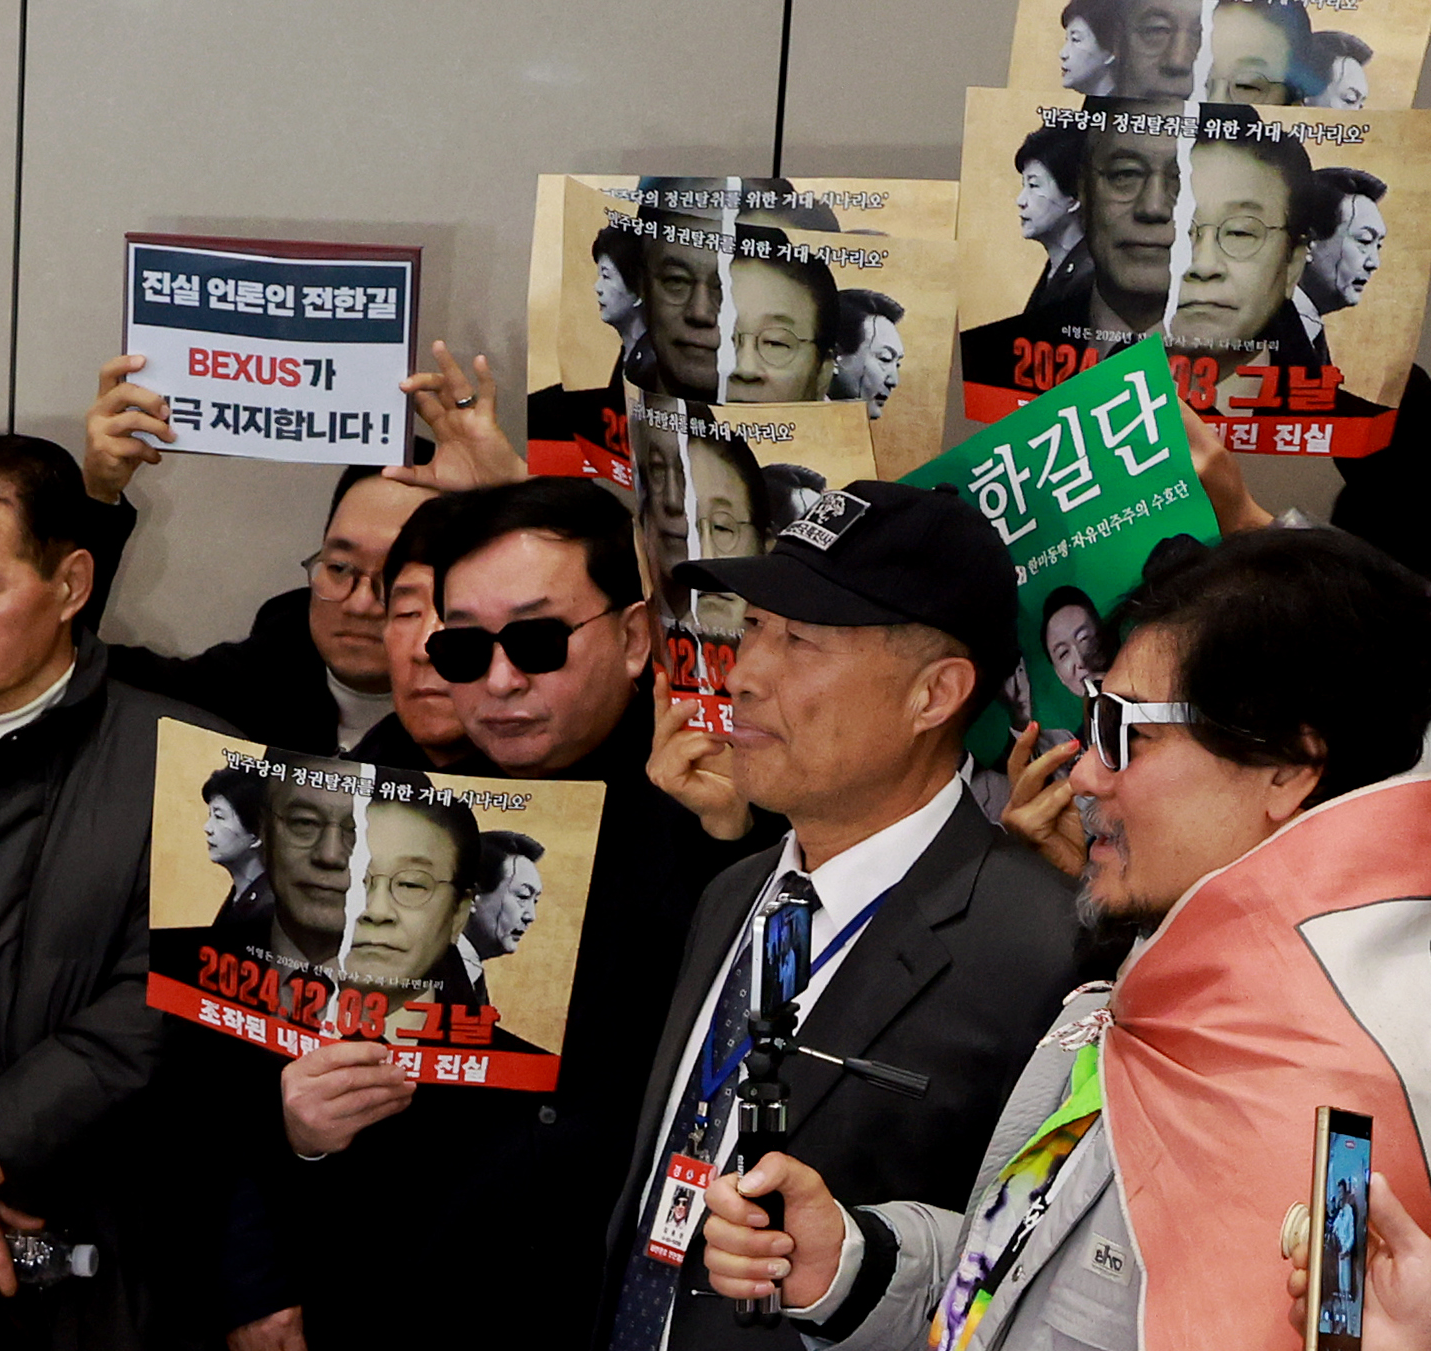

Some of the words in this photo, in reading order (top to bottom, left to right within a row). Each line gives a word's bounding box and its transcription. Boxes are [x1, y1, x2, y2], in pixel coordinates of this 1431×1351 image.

[1203, 117, 1242, 139] 위한
[1245, 120, 1282, 143] 거대
[746, 191, 778, 209] 위한
[782, 191, 815, 209] 거대
[740, 238, 773, 259] 위한
[776, 243, 810, 264] 거대
[142, 270, 201, 308] 진실
[207, 276, 295, 318] 언론인
[301, 285, 398, 320] 전한길
[188, 347, 337, 391] BEXUS가
[1228, 364, 1345, 411] 그날
[163, 394, 203, 432] 극
[1273, 422, 1334, 453] 진실
[1151, 479, 1191, 511] 수호단
[378, 773, 414, 801] 위한
[418, 784, 452, 807] 거대
[198, 945, 389, 1040] 2024.12.03
[395, 1002, 502, 1045] 그날
[198, 998, 267, 1044] 조작된
[434, 1054, 490, 1083] 진실
